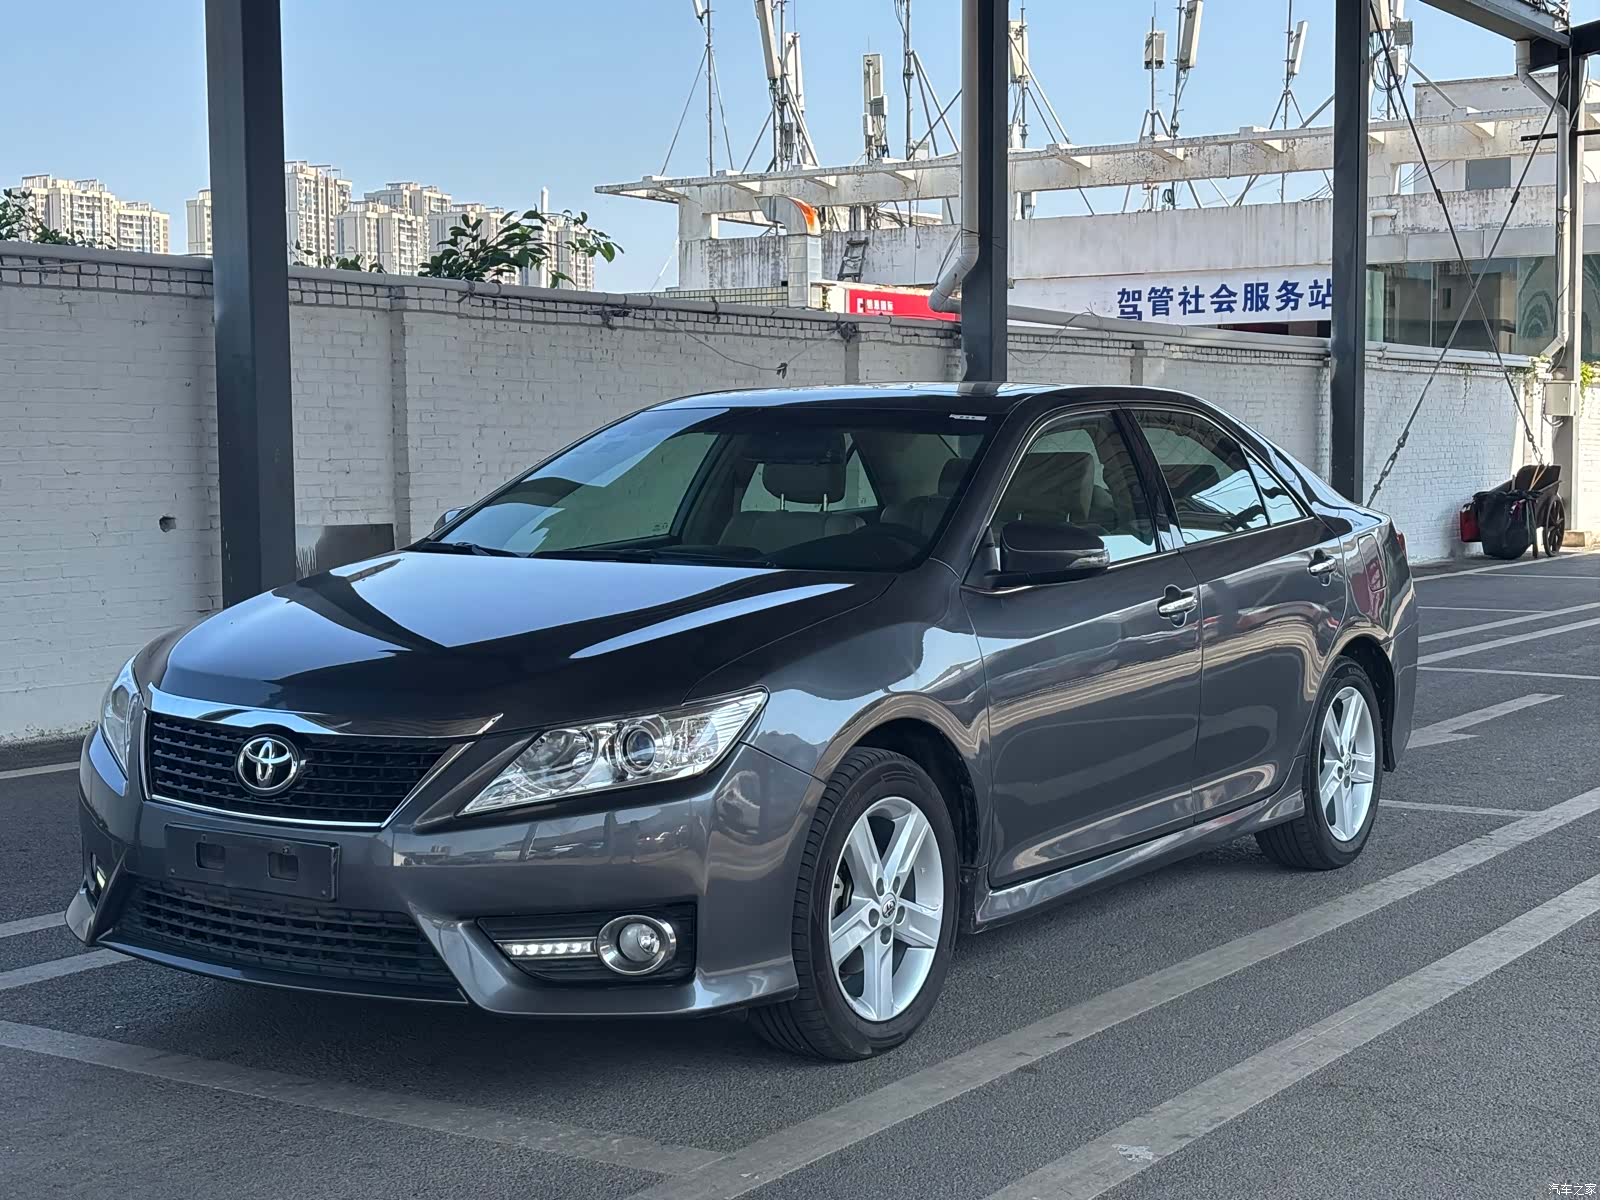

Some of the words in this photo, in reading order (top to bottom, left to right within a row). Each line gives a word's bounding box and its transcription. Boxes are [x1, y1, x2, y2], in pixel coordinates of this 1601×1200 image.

[1117, 279, 1332, 321] 驾管社会服务站
